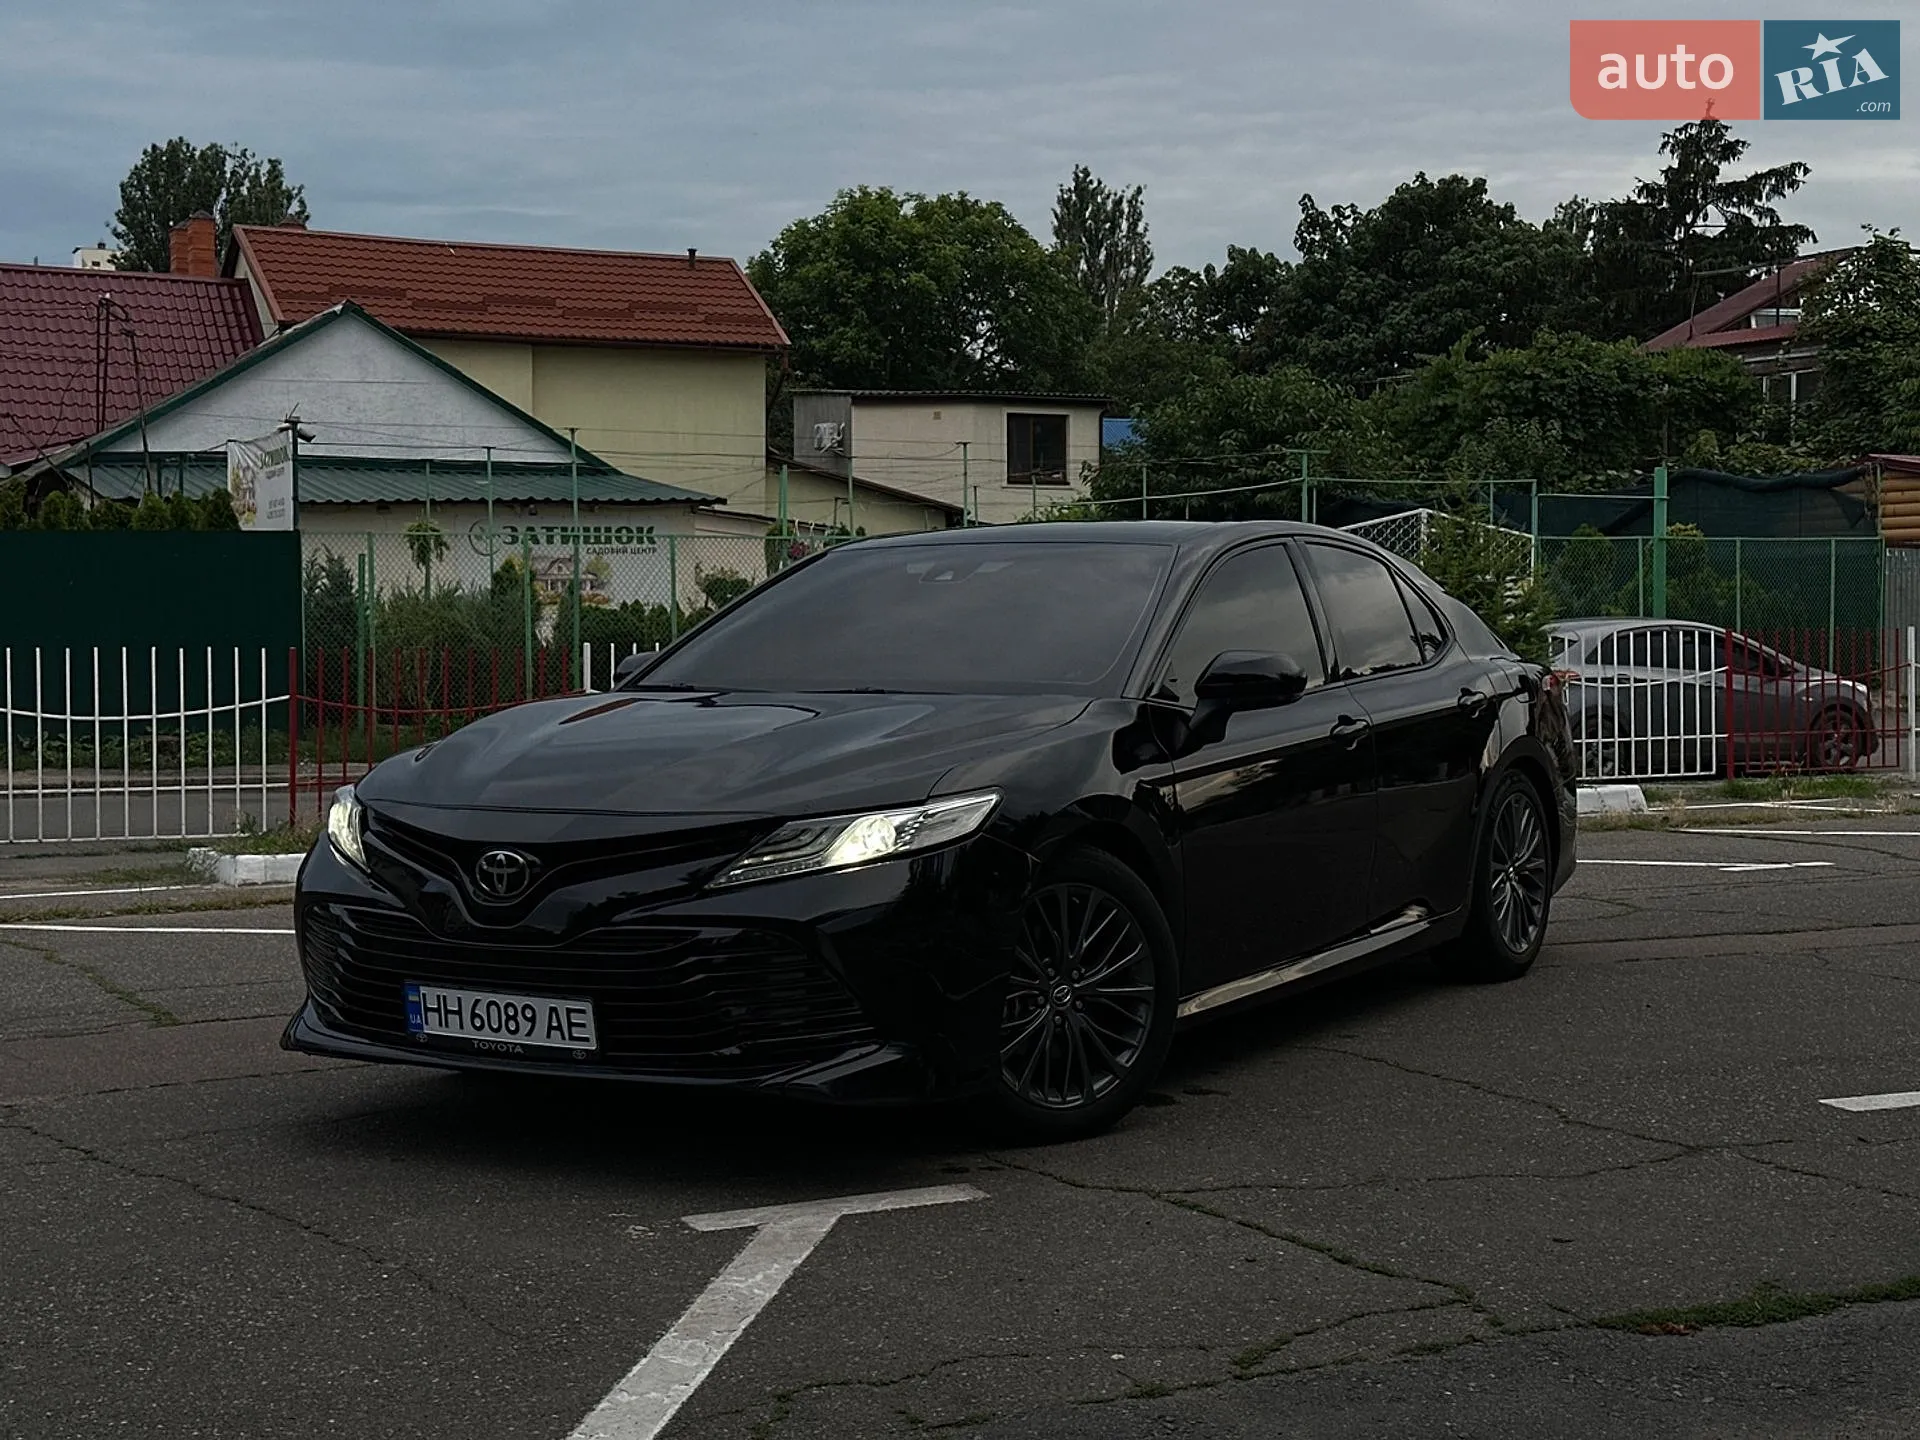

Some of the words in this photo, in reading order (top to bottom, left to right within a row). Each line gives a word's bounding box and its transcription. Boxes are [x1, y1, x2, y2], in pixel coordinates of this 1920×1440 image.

[502, 525, 657, 545] ЗАТИШОК
[586, 546, 629, 556] САДОВИЙ
[630, 547, 657, 555] ЦЕНТР
[410, 1013, 422, 1025] UA
[470, 999, 537, 1037] 6089
[546, 1005, 590, 1043] AE
[472, 1040, 524, 1054] TOYOTA
